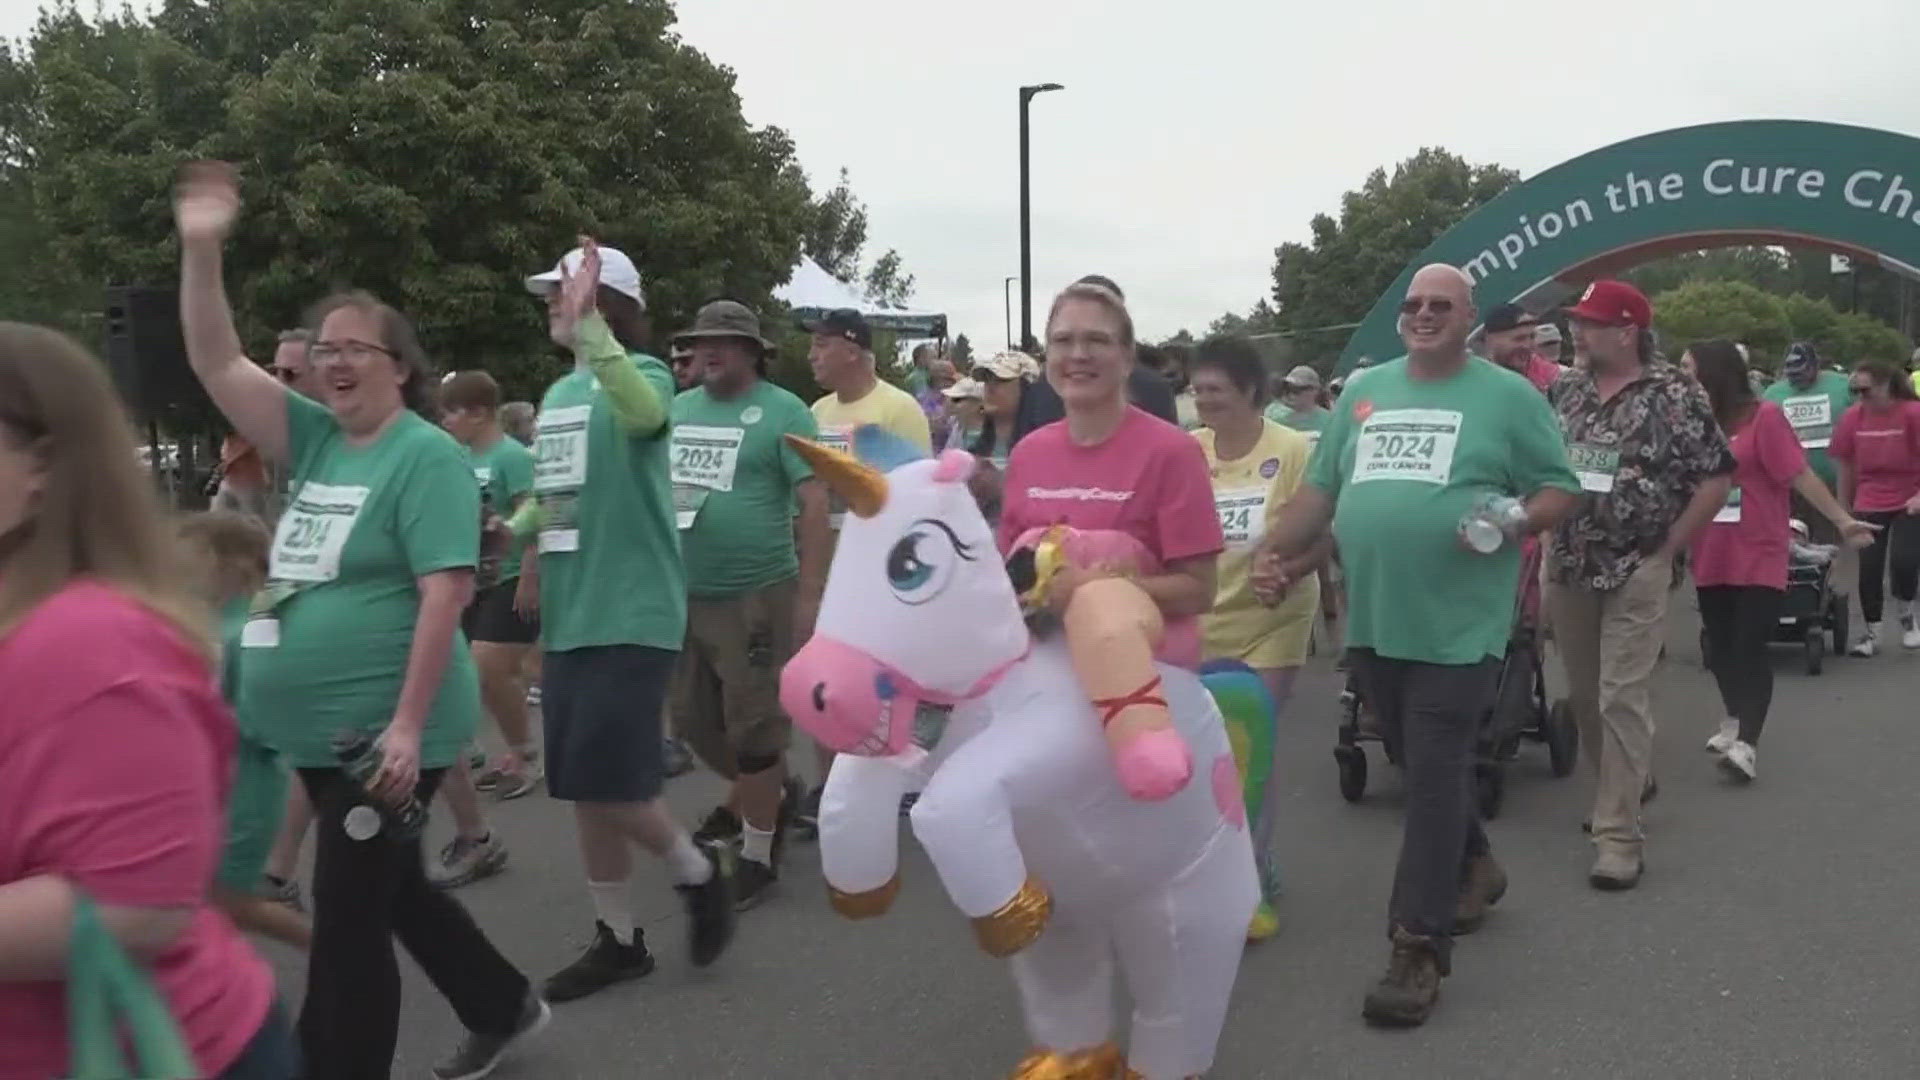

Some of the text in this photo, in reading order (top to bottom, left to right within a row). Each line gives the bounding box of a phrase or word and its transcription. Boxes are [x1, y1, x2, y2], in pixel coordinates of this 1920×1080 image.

[1460, 198, 1593, 287] mpion
[1604, 171, 1684, 213] the
[1702, 158, 1825, 198] Cure
[676, 447, 724, 469] 2024
[1372, 434, 1437, 459] 2024
[1216, 508, 1250, 530] 24
